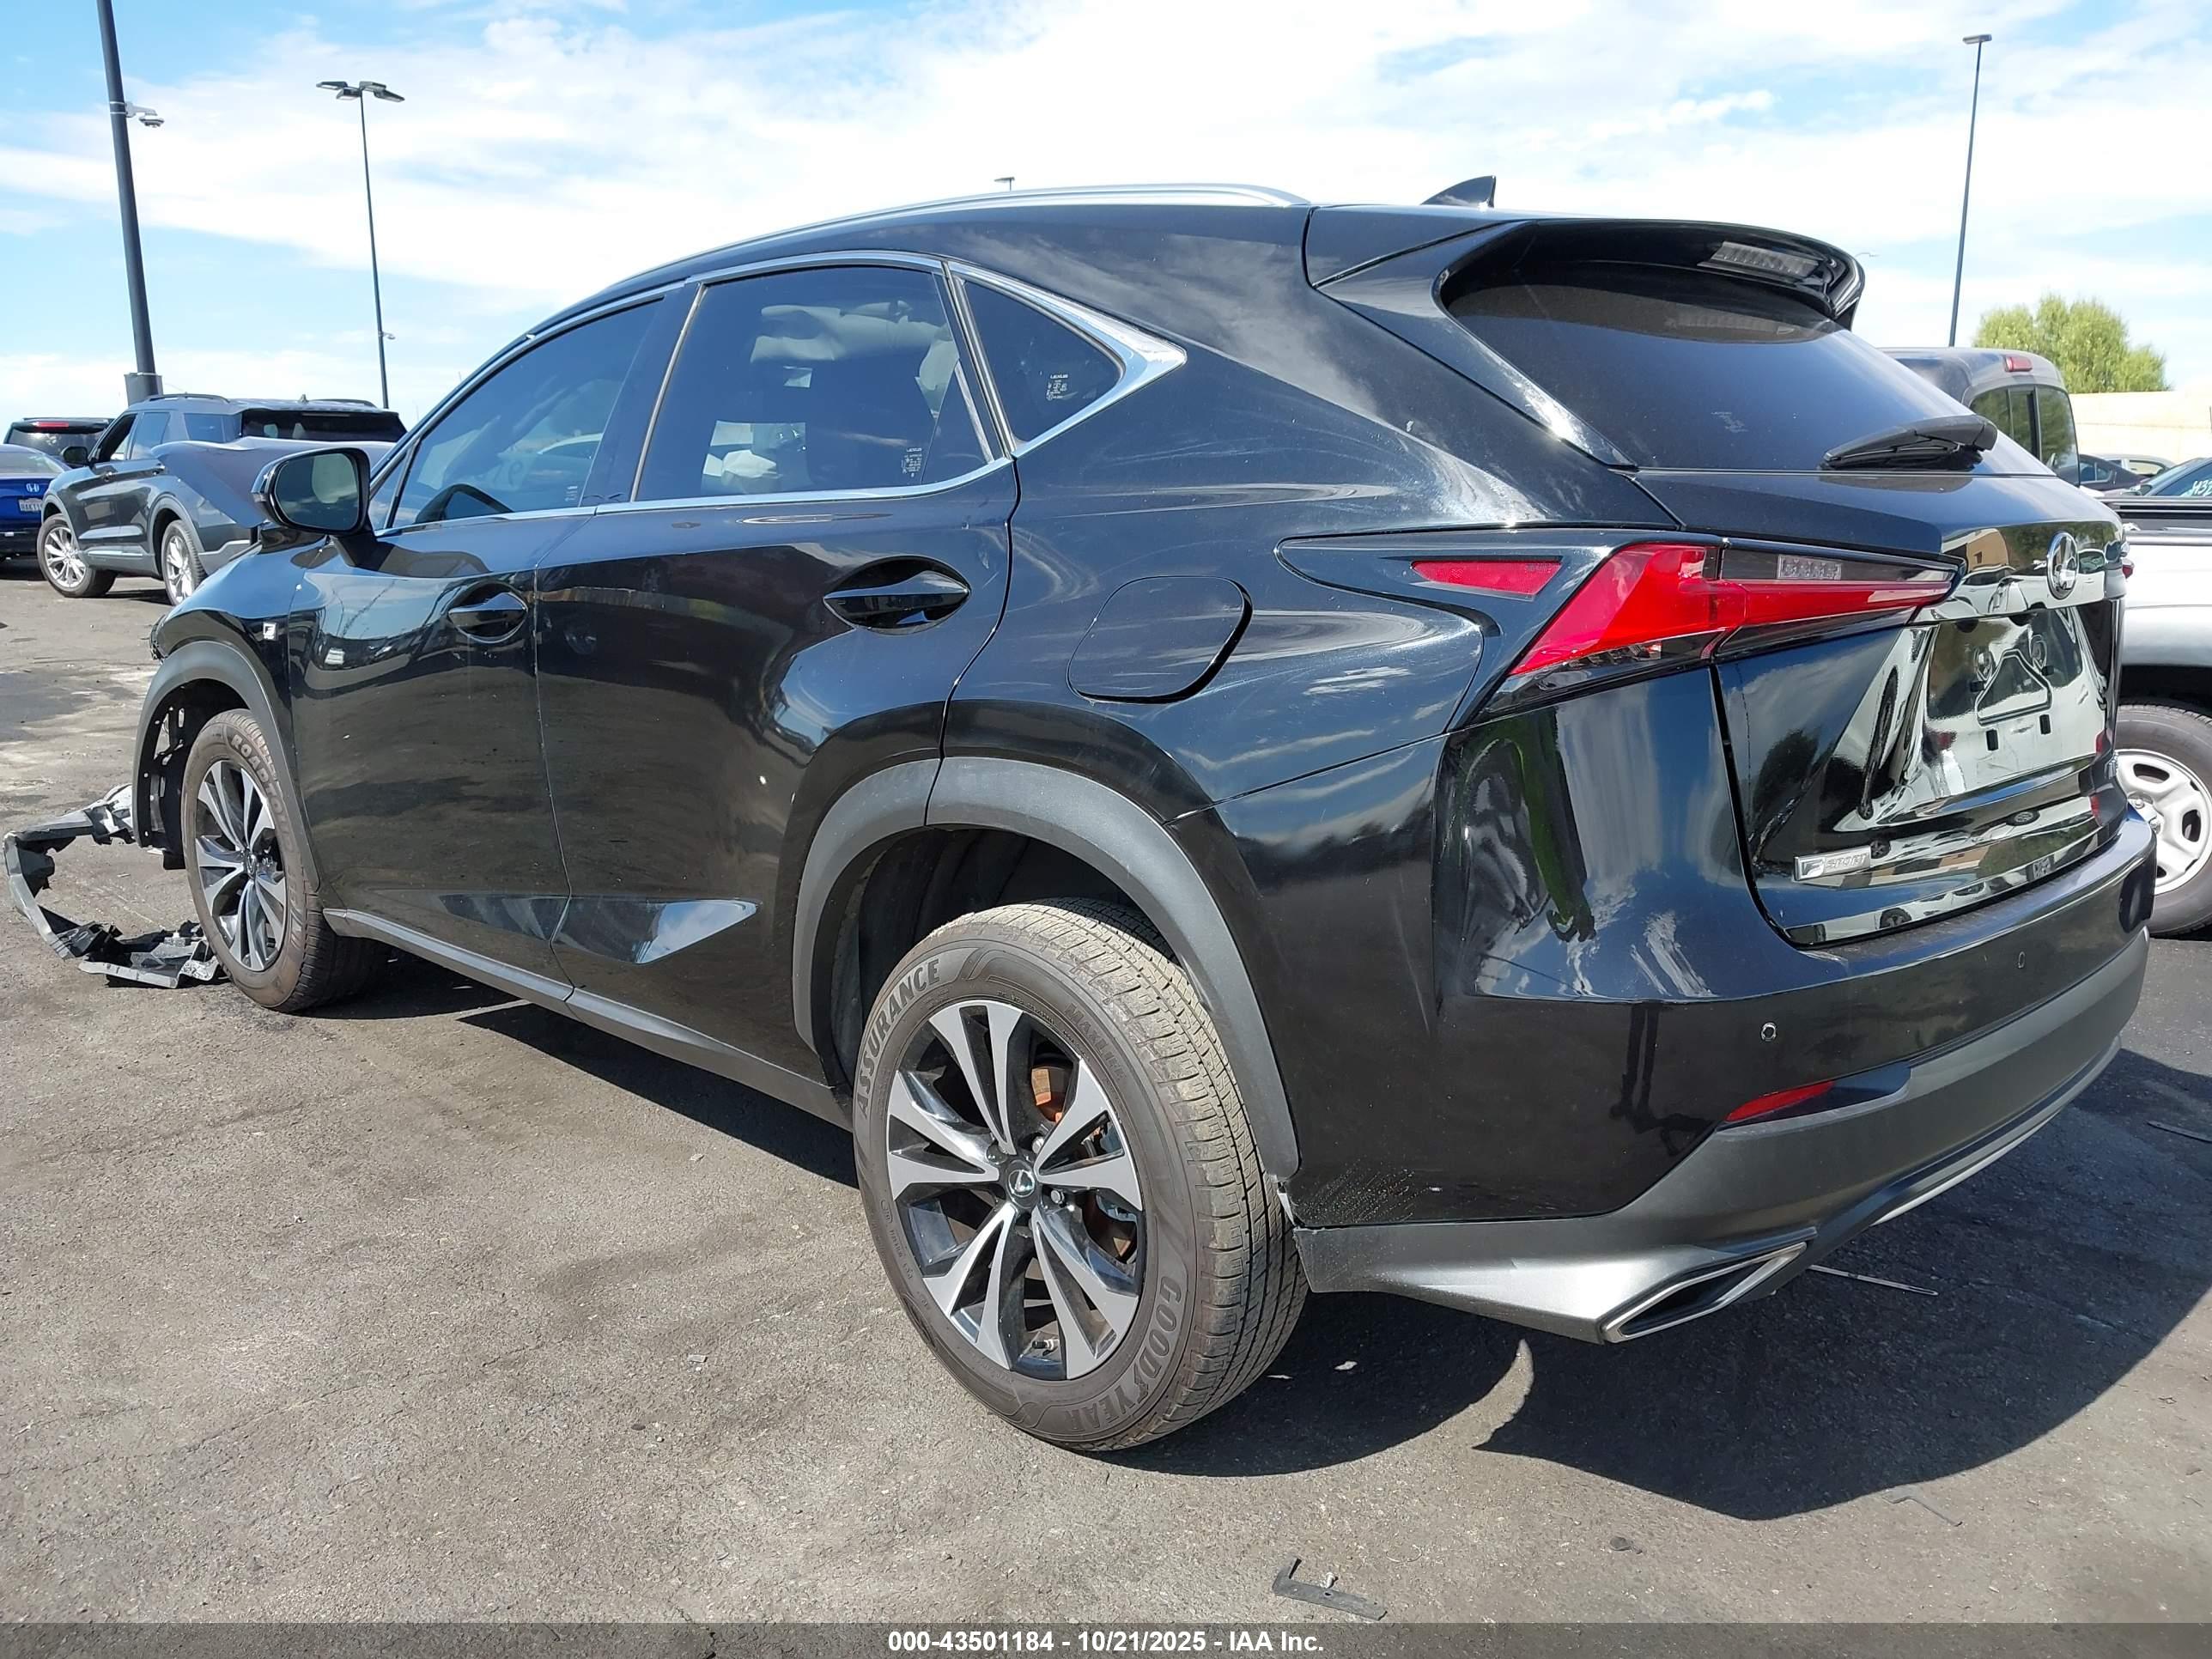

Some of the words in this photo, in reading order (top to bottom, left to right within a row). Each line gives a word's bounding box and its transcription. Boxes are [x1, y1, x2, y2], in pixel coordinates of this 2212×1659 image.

[1826, 853, 1869, 869] SPORT
[856, 957, 940, 1119] ASSURANCE
[1064, 1002, 1127, 1082] MAXLIFE
[1065, 1275, 1183, 1432] GOODYEAR
